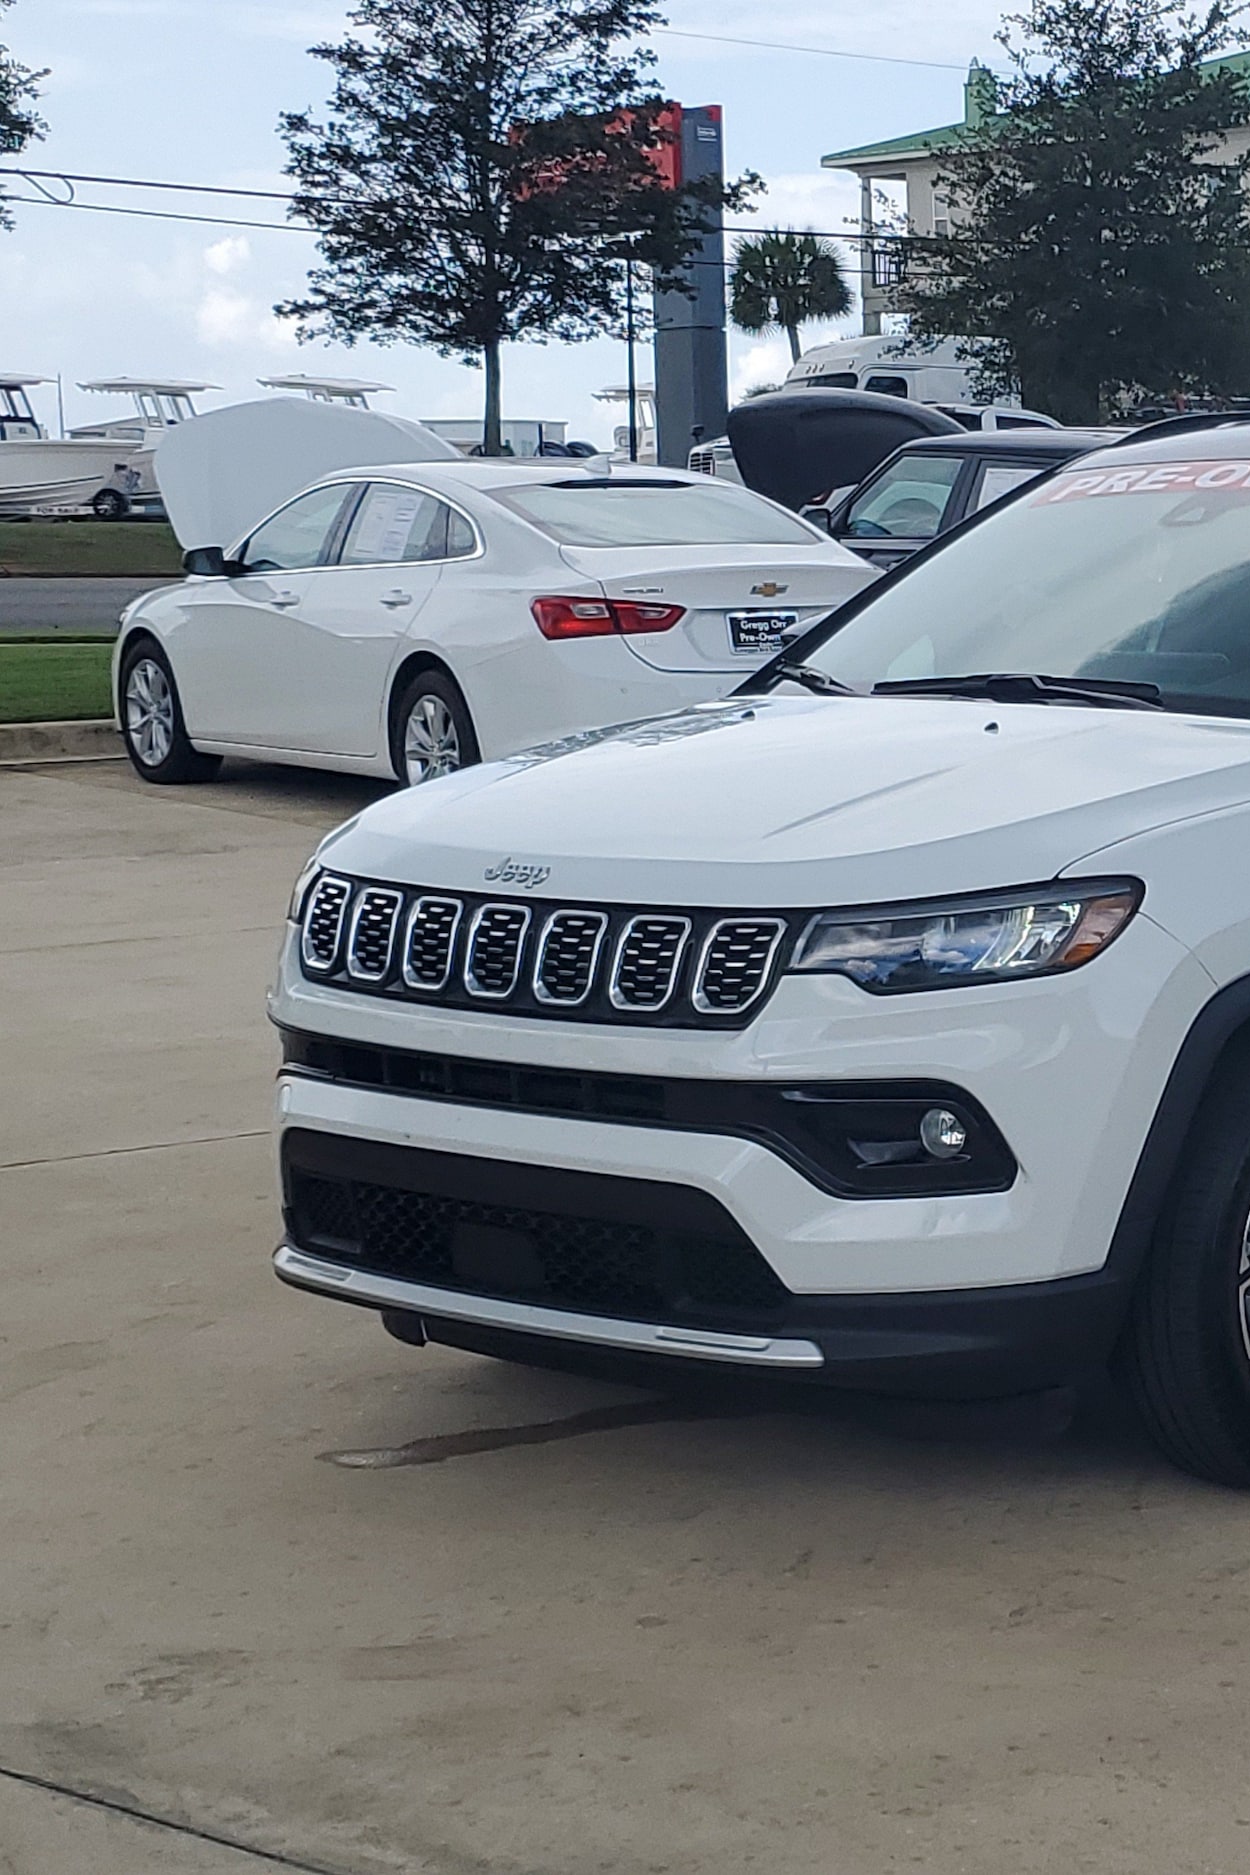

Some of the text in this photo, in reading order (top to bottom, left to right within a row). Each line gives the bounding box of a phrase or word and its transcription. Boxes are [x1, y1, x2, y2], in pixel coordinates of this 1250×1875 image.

[740, 619, 787, 631] Gregg Orr
[484, 856, 551, 889] Jeep
